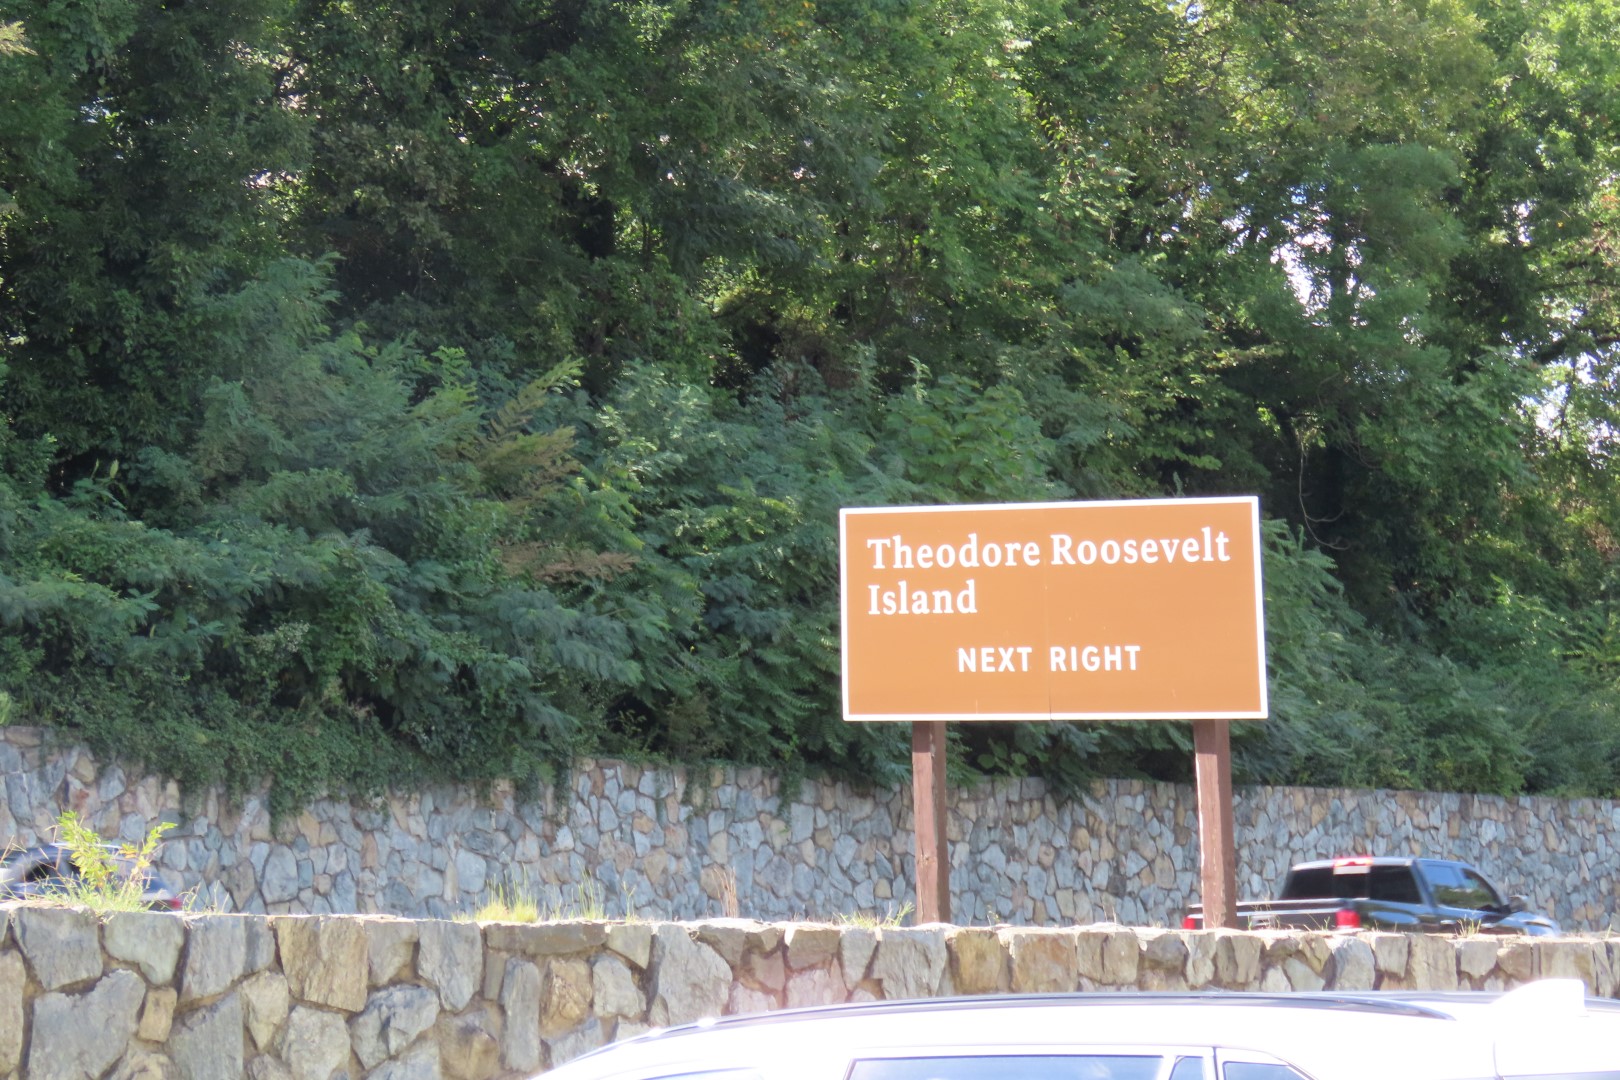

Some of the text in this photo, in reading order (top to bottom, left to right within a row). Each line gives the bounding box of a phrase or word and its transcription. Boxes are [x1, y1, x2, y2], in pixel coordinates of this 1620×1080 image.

[866, 525, 1231, 569] Theodore Roosevelt
[867, 578, 978, 615] Island
[956, 644, 1141, 672] NEXT RIGHT
